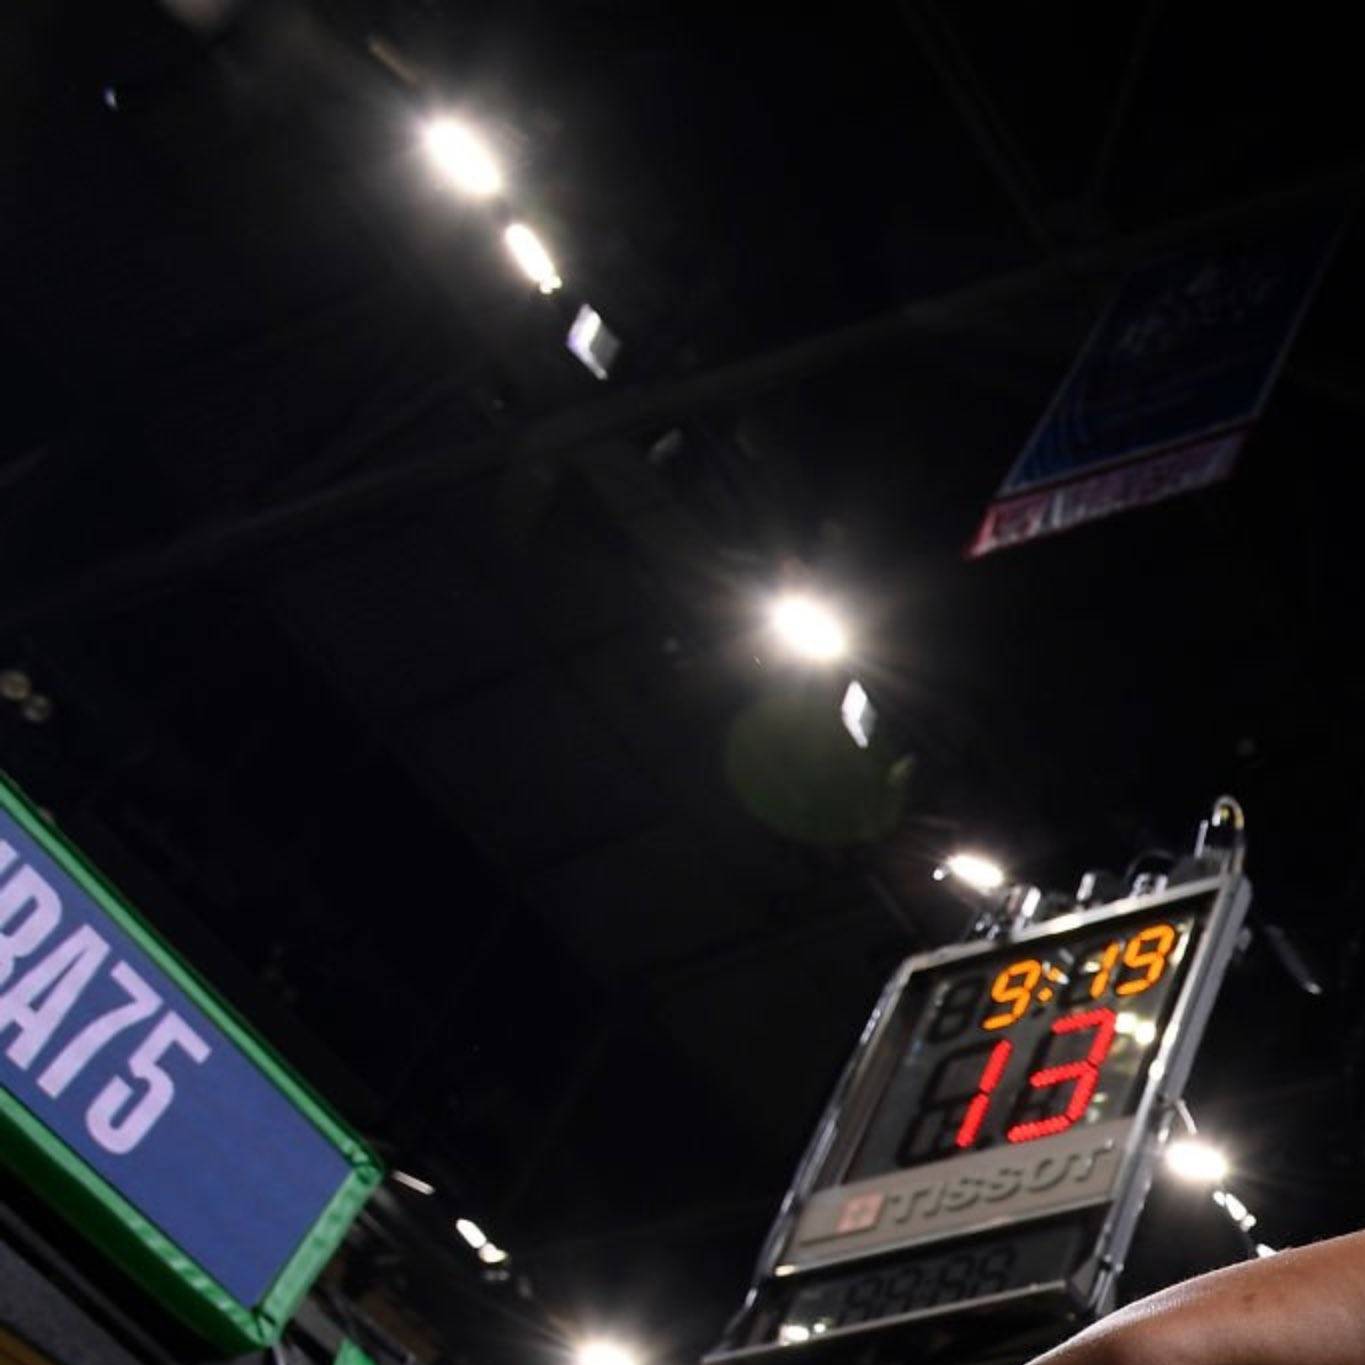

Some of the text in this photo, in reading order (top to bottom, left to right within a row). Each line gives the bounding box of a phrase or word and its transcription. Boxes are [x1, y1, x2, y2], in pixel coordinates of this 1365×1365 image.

[0, 837, 212, 1156] BA75
[983, 922, 1178, 1032] 9:19
[954, 1006, 1118, 1149] 13
[885, 1144, 1110, 1226] TISSOT
